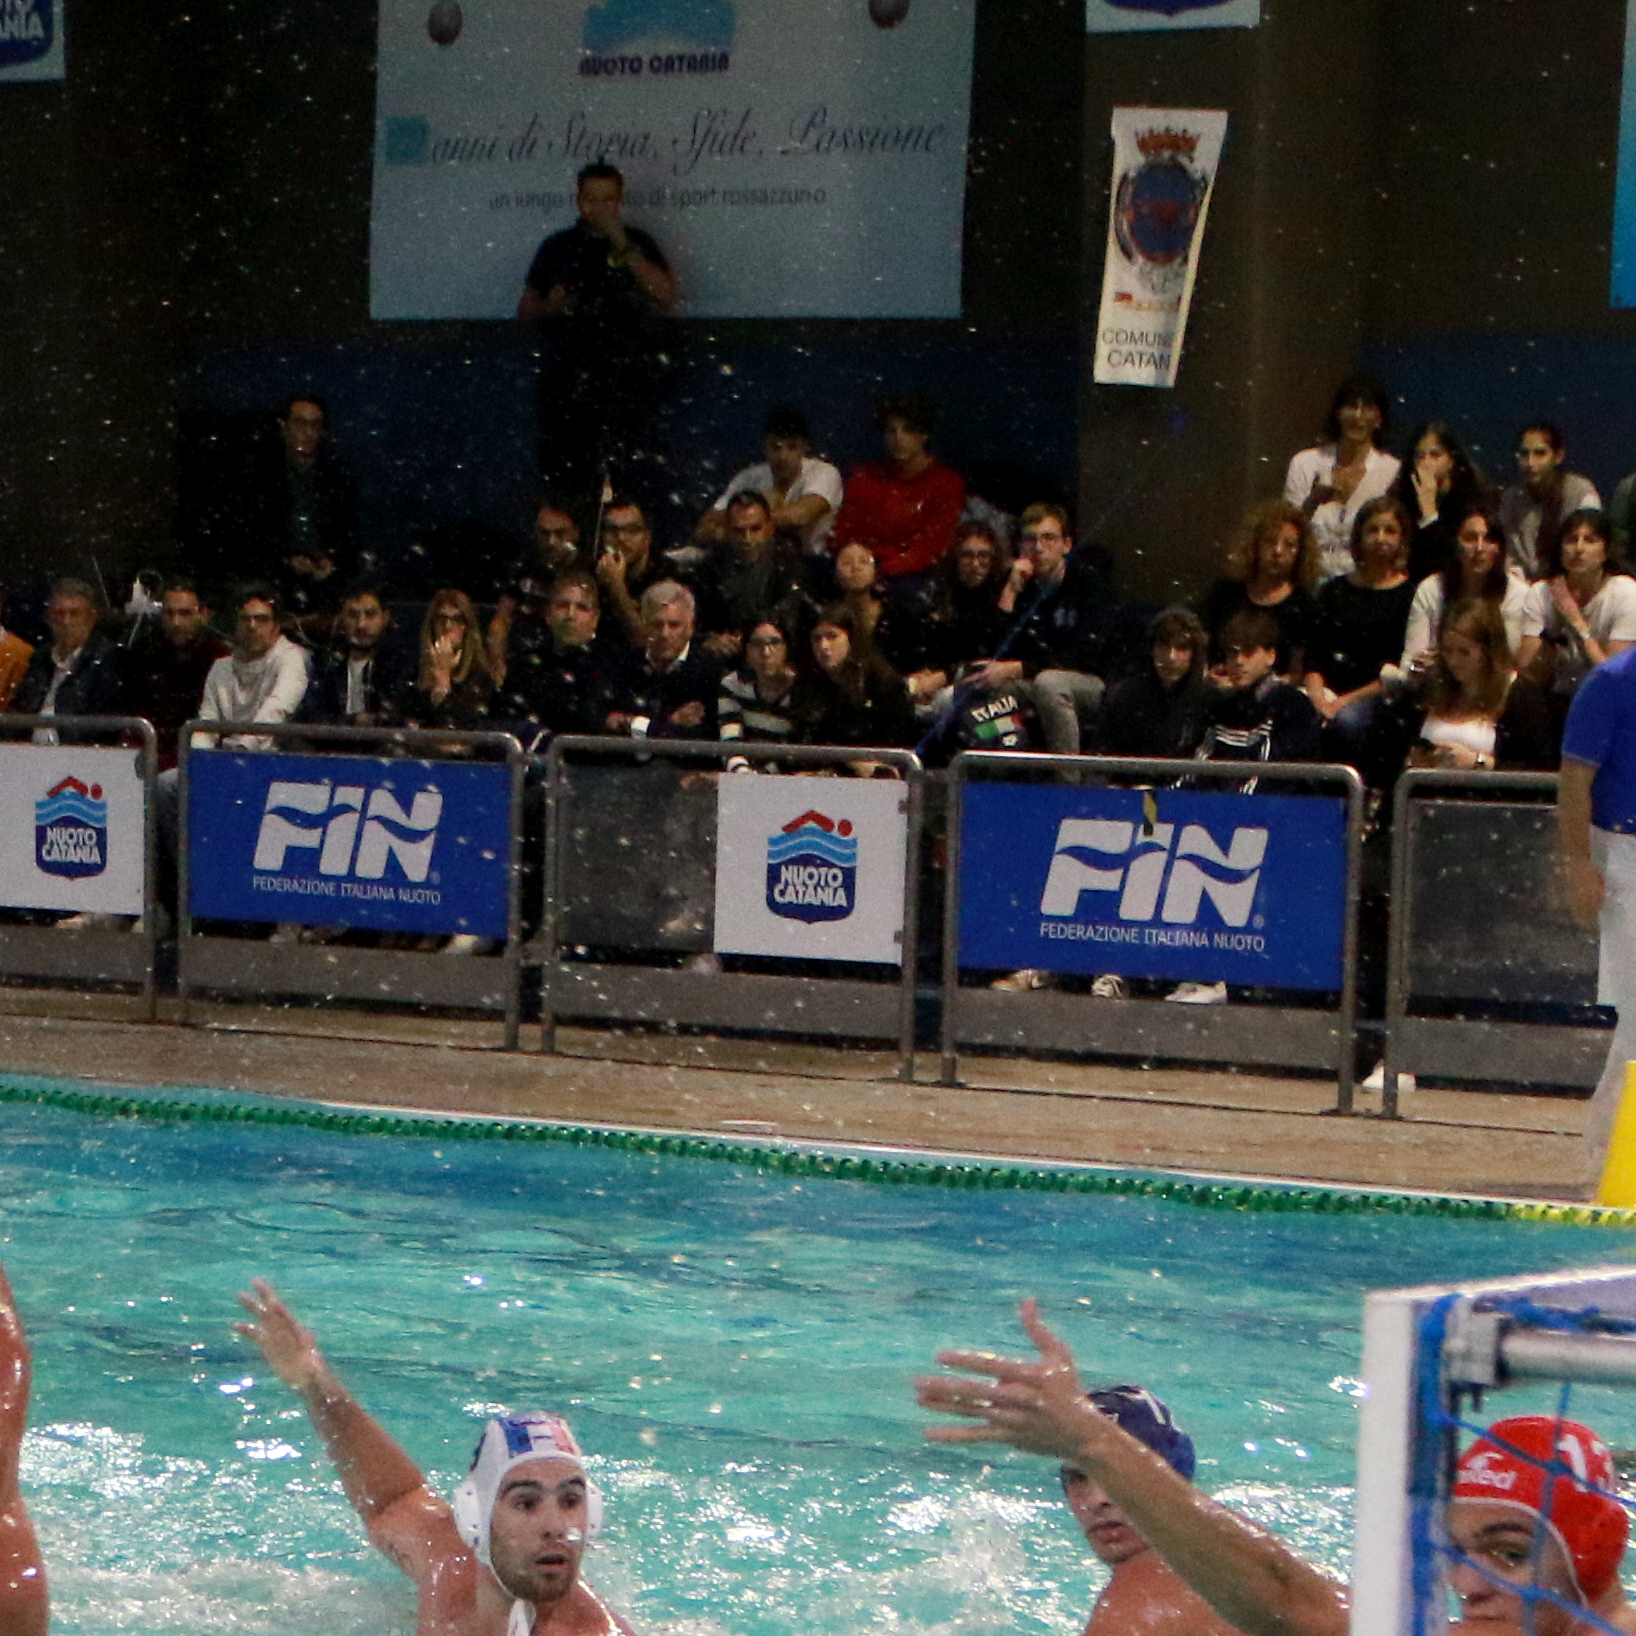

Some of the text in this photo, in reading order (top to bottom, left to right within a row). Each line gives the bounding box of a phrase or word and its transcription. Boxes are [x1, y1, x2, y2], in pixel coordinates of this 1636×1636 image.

[579, 52, 729, 76] NUOTO CATANIA
[970, 694, 1019, 723] ITALIA
[46, 825, 98, 848] NUOTO
[252, 780, 444, 884] FIN
[41, 842, 102, 865] CATANIA
[780, 863, 844, 888] NUOTO
[1040, 817, 1269, 928] FIN
[252, 874, 442, 906] FEDERAZIONE ITALIANA NUOTO
[773, 882, 848, 908] CATANIA
[1039, 921, 1267, 953] FEDERAZIONE ITALIANA NUOTO
